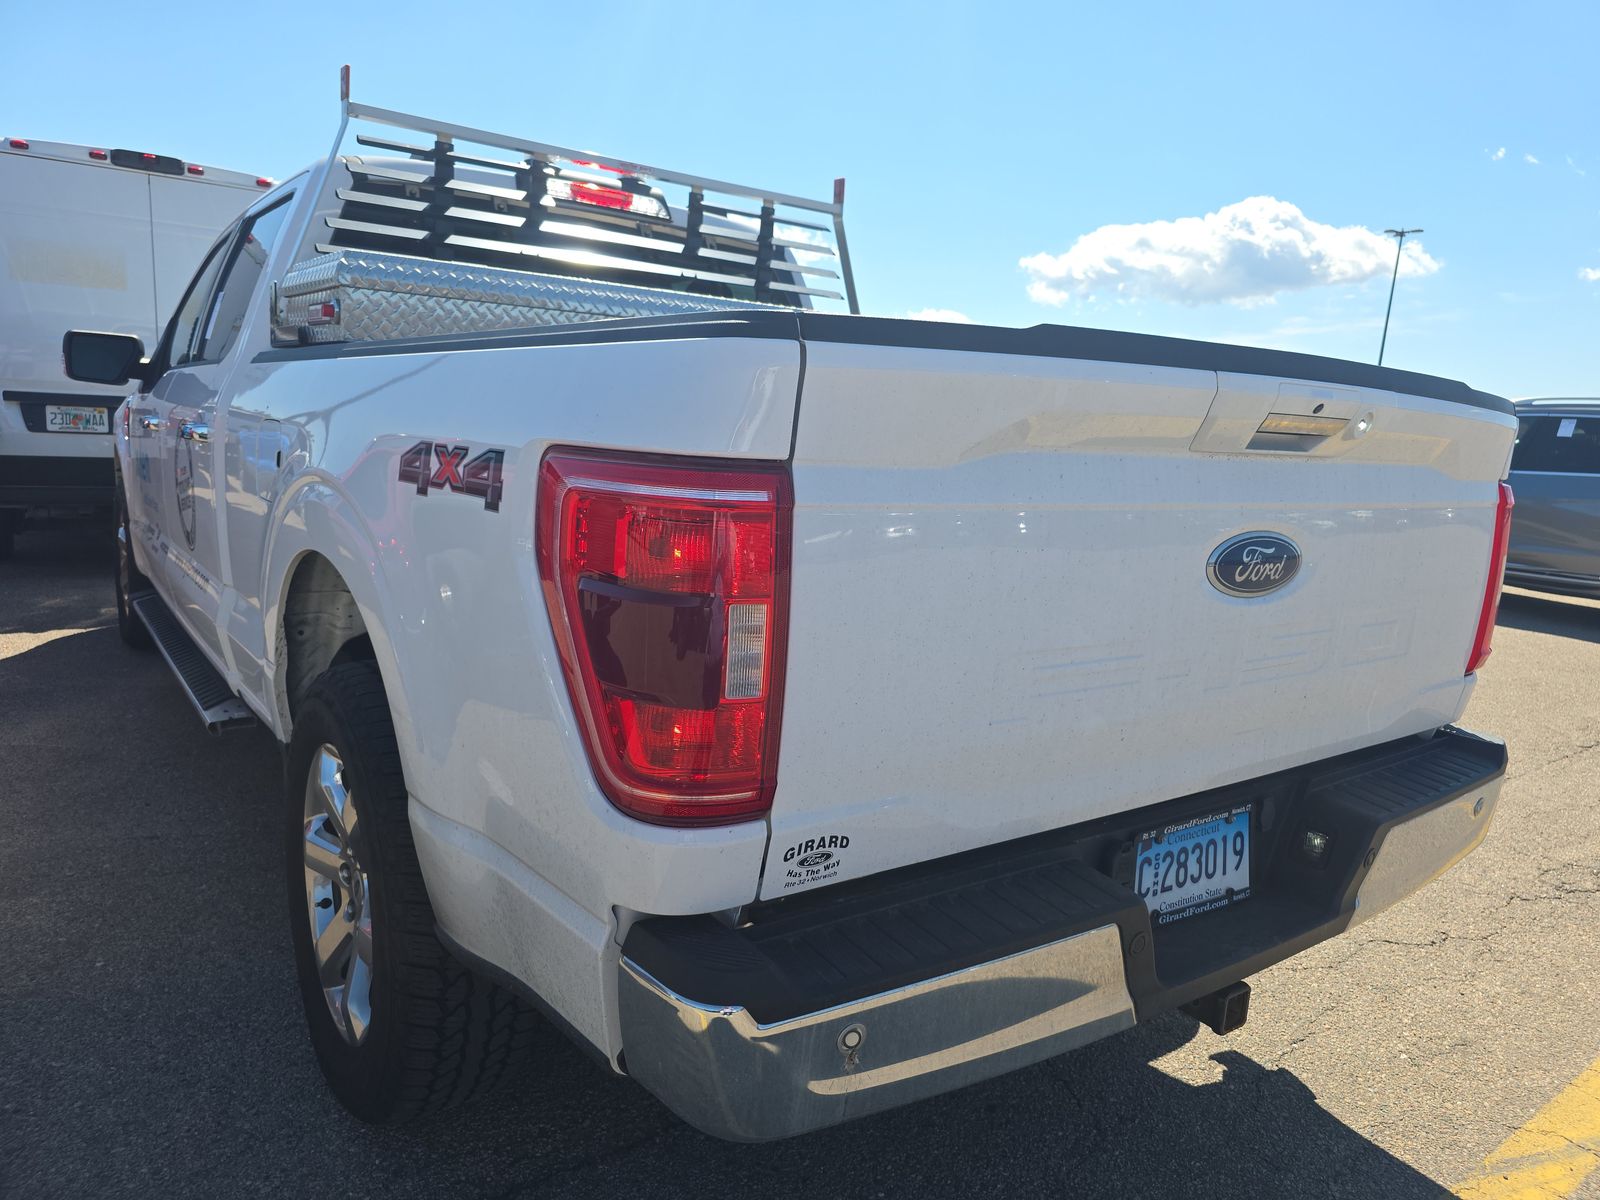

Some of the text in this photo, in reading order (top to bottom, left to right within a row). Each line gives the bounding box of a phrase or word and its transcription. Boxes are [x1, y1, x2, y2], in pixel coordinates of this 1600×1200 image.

[398, 440, 505, 514] 4X4
[1235, 546, 1287, 583] Ford
[1164, 811, 1229, 835] GirardFord.com
[1167, 822, 1221, 846] Connecticut
[783, 835, 850, 862] GIRARD
[1160, 830, 1245, 894] 283019
[786, 859, 841, 878] Has The Way
[1158, 897, 1229, 925] GirardFord.com
[1159, 890, 1204, 912] Constitution
[1205, 887, 1222, 899] State
